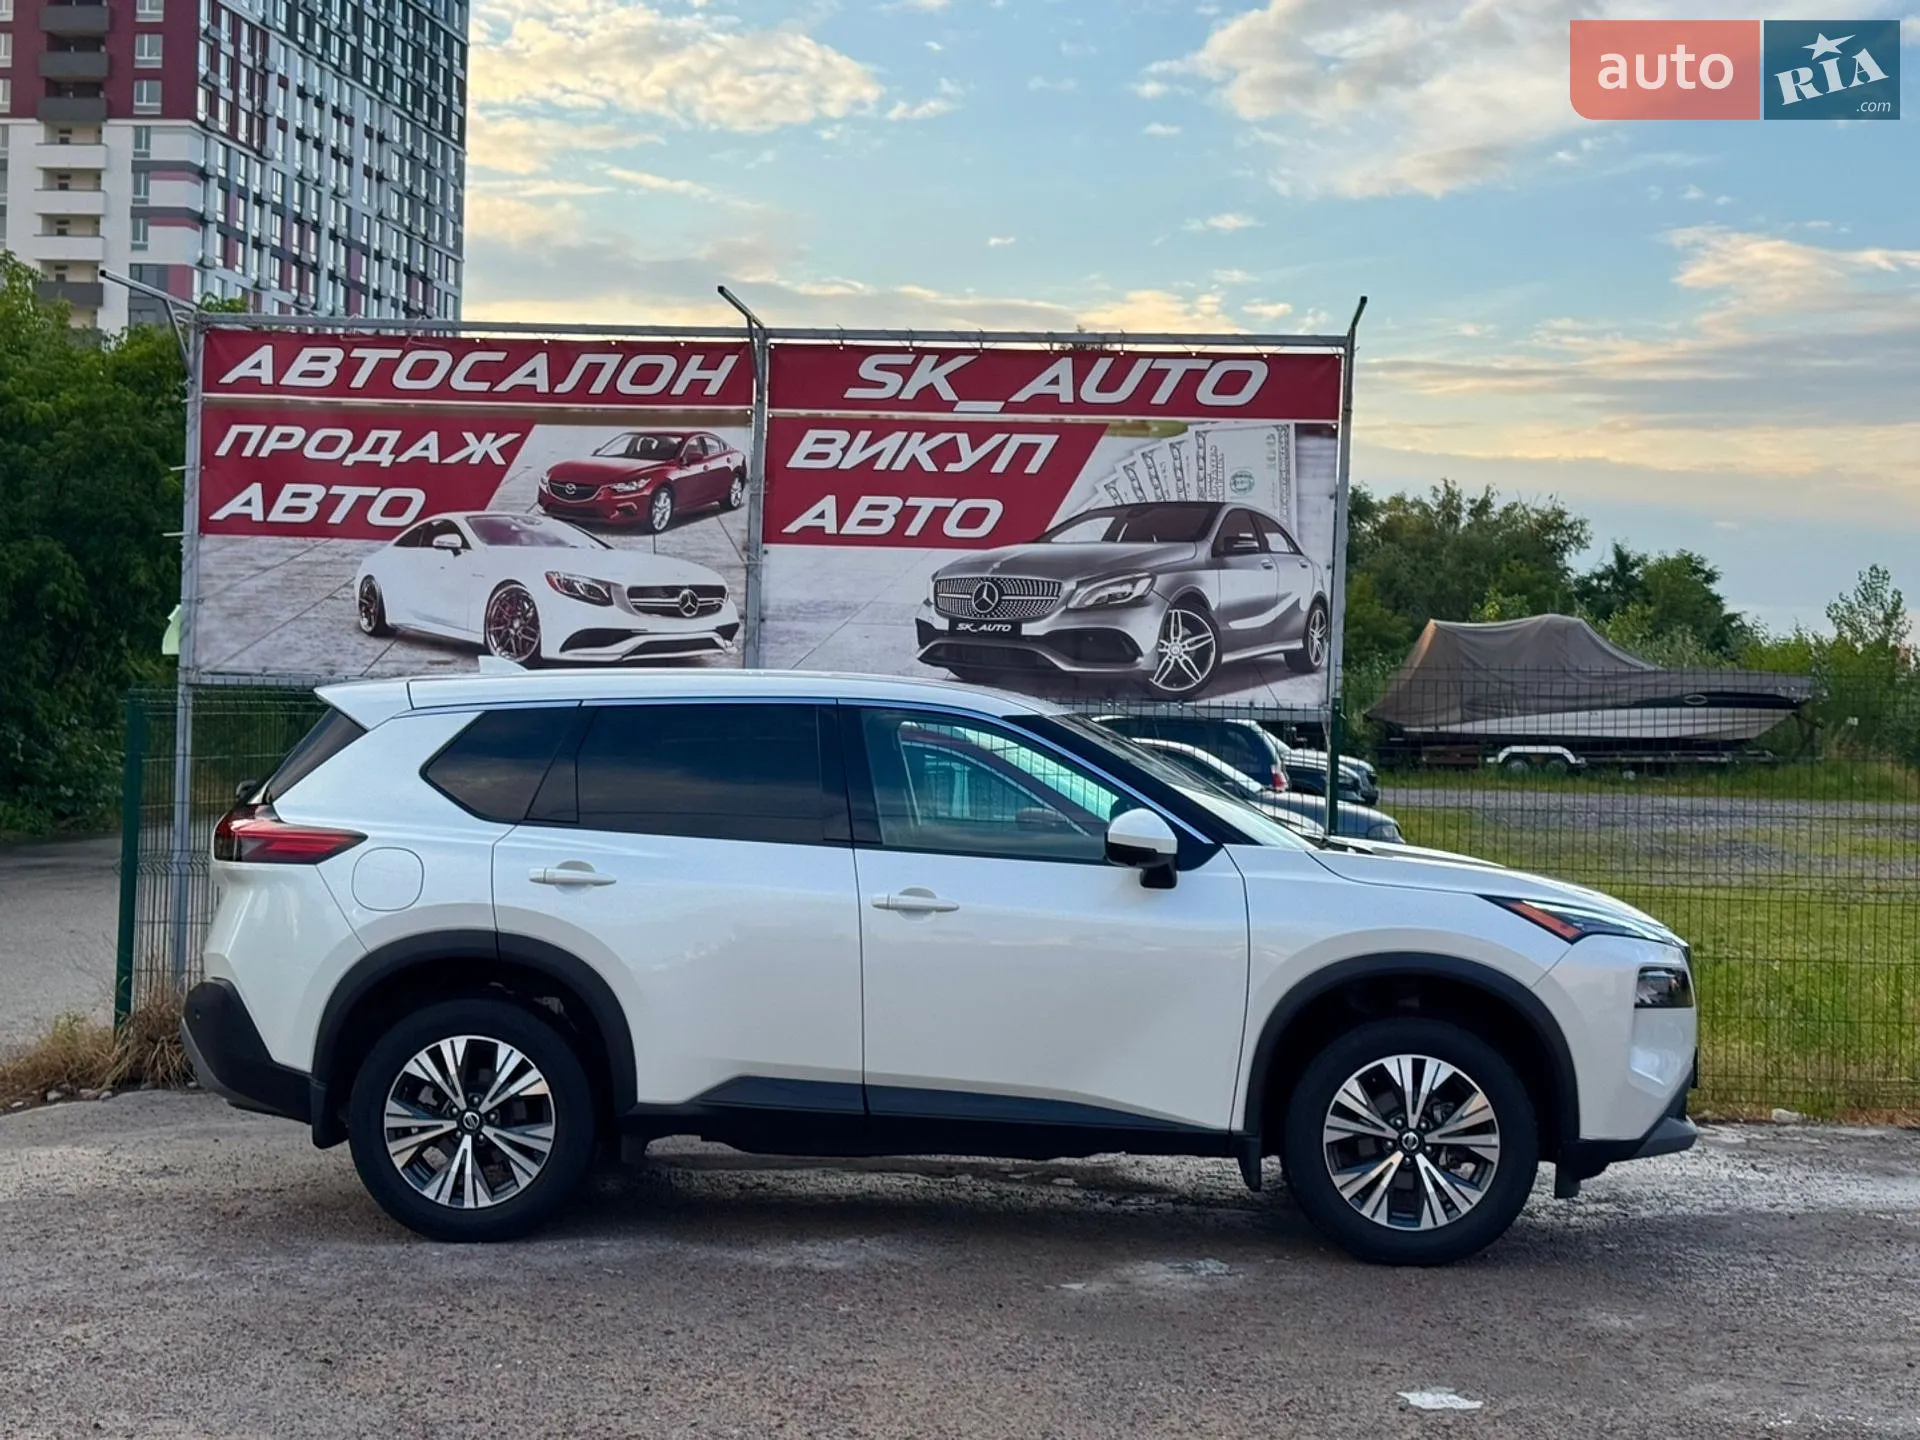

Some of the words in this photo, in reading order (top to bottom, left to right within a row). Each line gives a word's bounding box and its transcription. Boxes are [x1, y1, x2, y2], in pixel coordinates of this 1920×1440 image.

[217, 344, 739, 396] АВТОСАЛОН
[843, 352, 1269, 412] SK_AUTO
[214, 423, 522, 467] ПРОДАЖ
[785, 428, 1060, 474] ВИКУП
[208, 481, 426, 528] АВТО
[781, 494, 1004, 538] АВТО
[955, 622, 1012, 633] SK_AUTO
